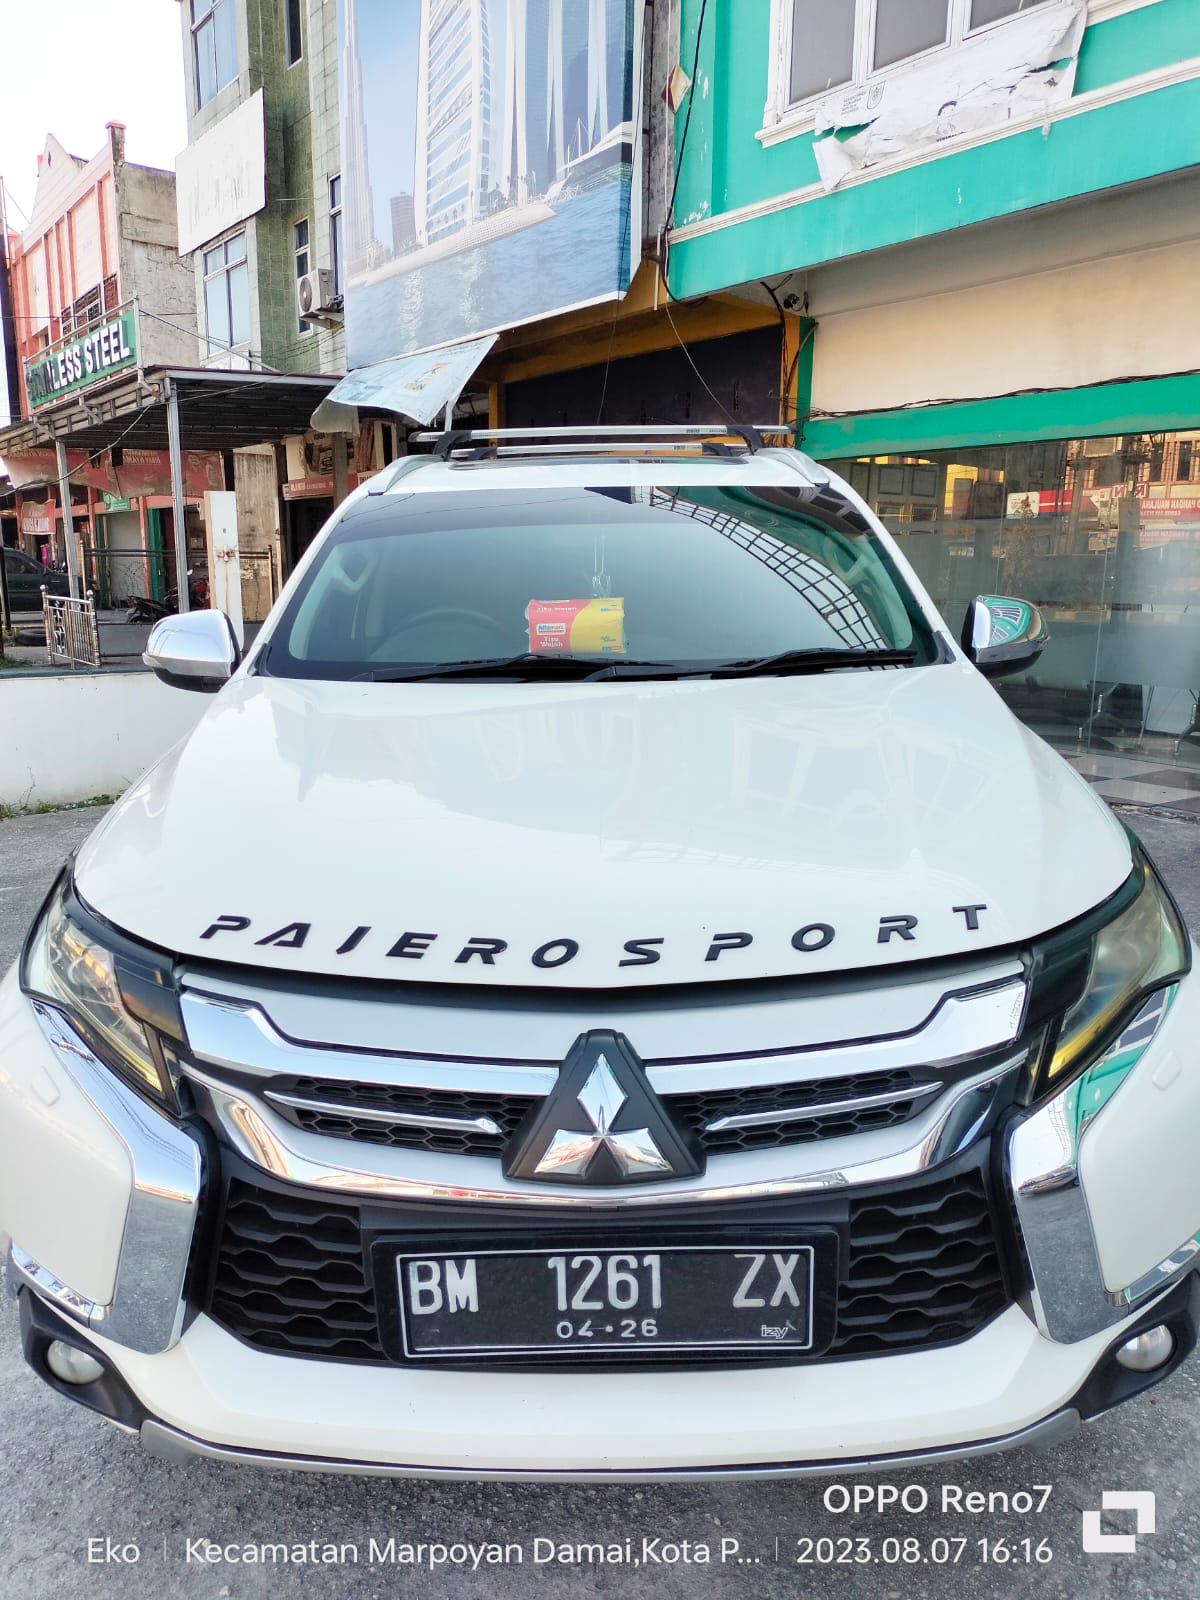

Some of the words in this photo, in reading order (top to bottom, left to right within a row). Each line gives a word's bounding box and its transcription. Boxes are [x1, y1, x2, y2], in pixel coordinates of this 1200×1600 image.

[84, 319, 131, 374] STEEL
[200, 915, 579, 968] PAJERO
[619, 904, 988, 967] SPORT
[409, 1258, 480, 1316] BM
[547, 1254, 663, 1311] 1261
[732, 1254, 801, 1308] ZX
